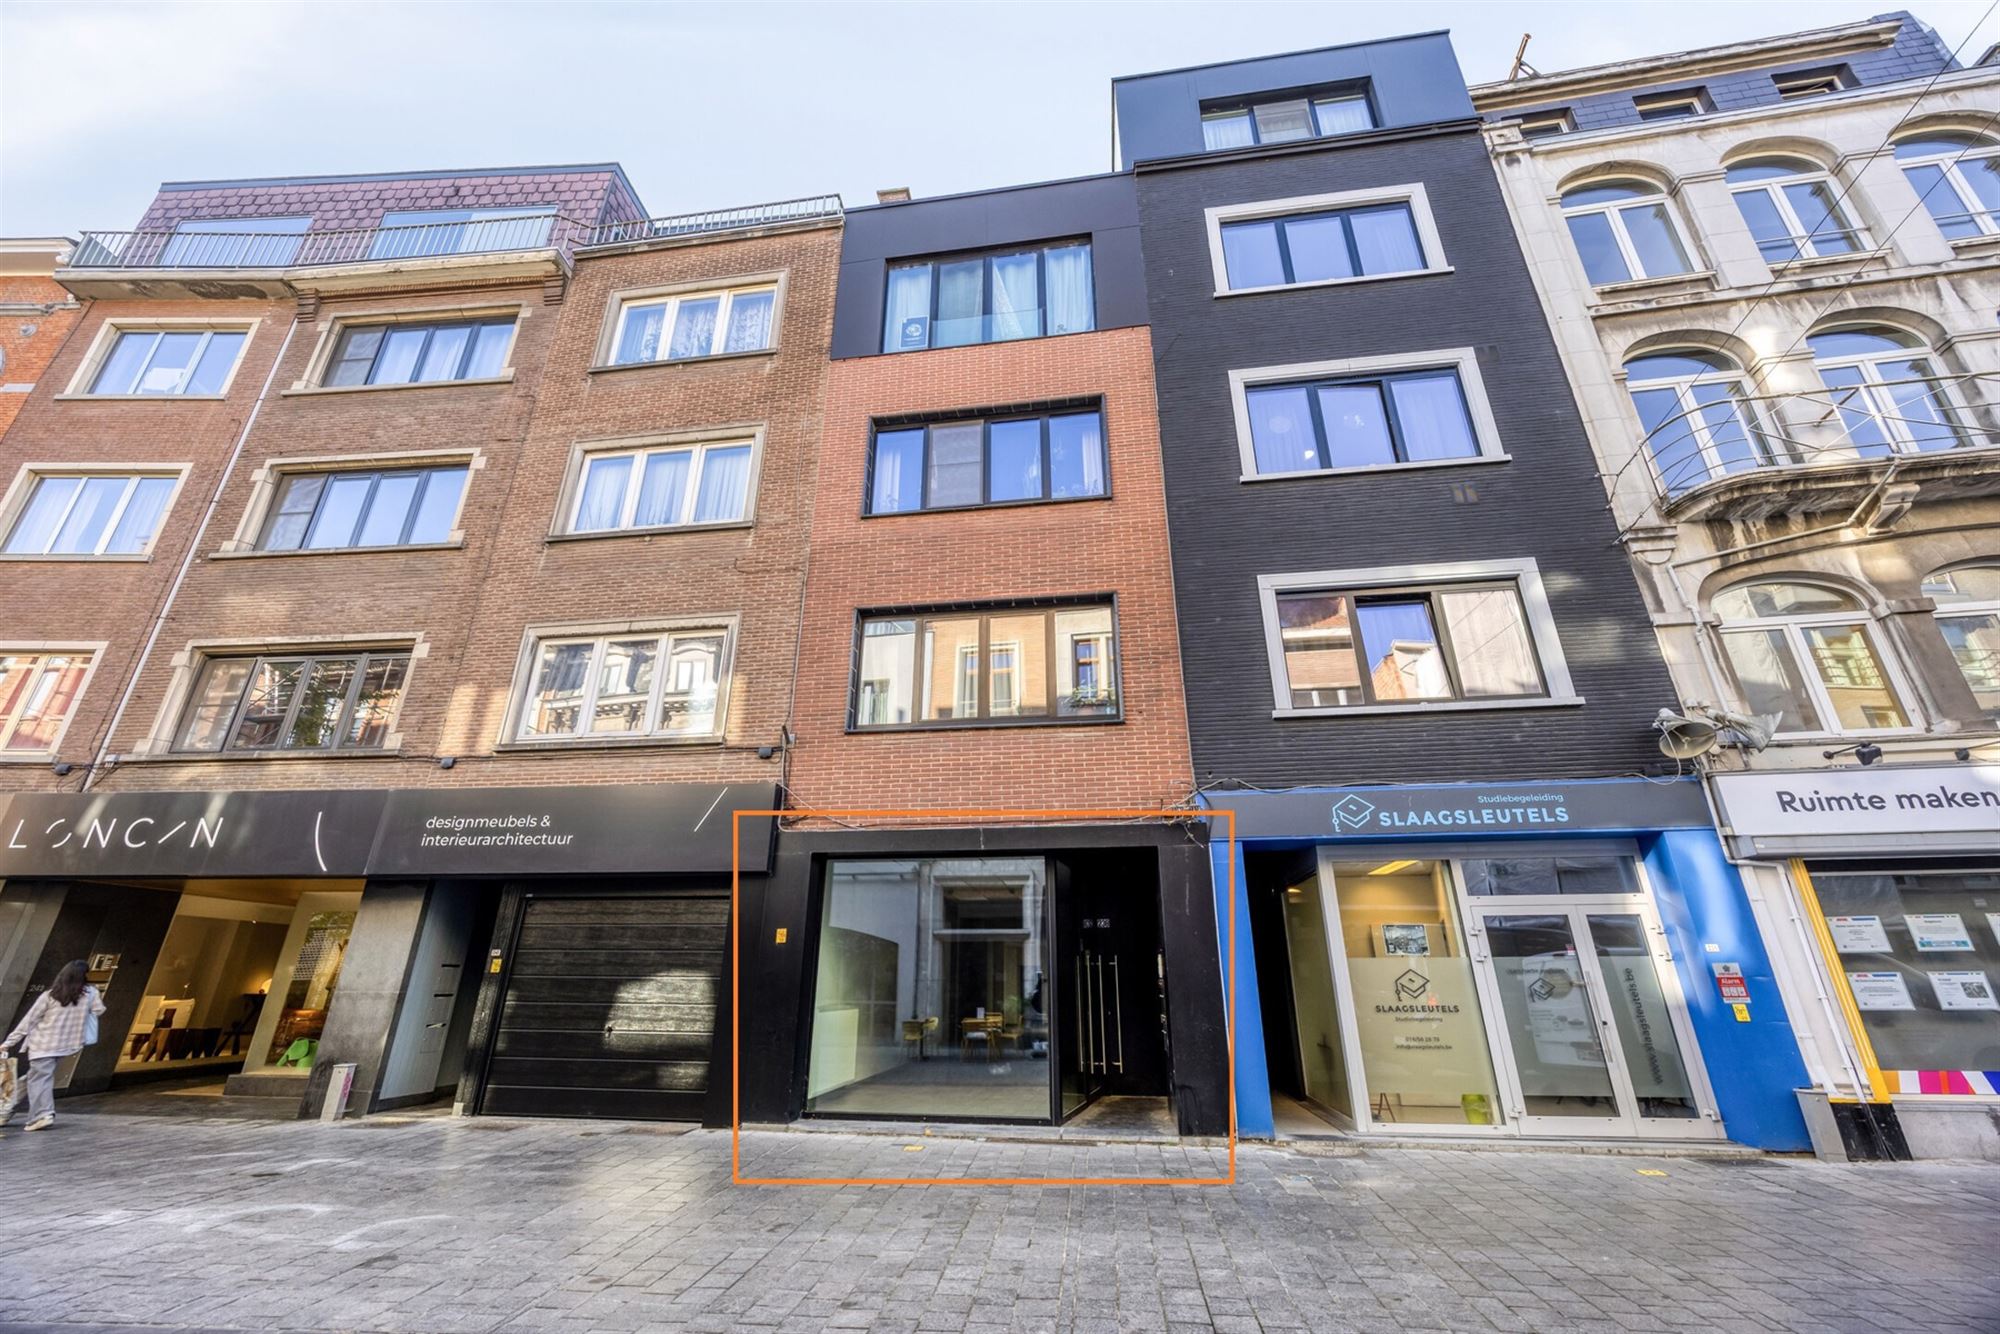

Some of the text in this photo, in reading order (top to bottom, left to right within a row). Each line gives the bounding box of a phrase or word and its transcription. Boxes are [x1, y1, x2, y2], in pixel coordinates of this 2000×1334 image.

[1477, 793, 1564, 804] Studiebegeleiding
[1776, 786, 2000, 813] Ruimte maken
[425, 814, 551, 831] designmeubels &
[1378, 806, 1569, 827] SLAAGSLEUTELS
[421, 832, 573, 847] interieurarchitectuur
[1375, 1004, 1460, 1013] SLAAGSLEUTELS
